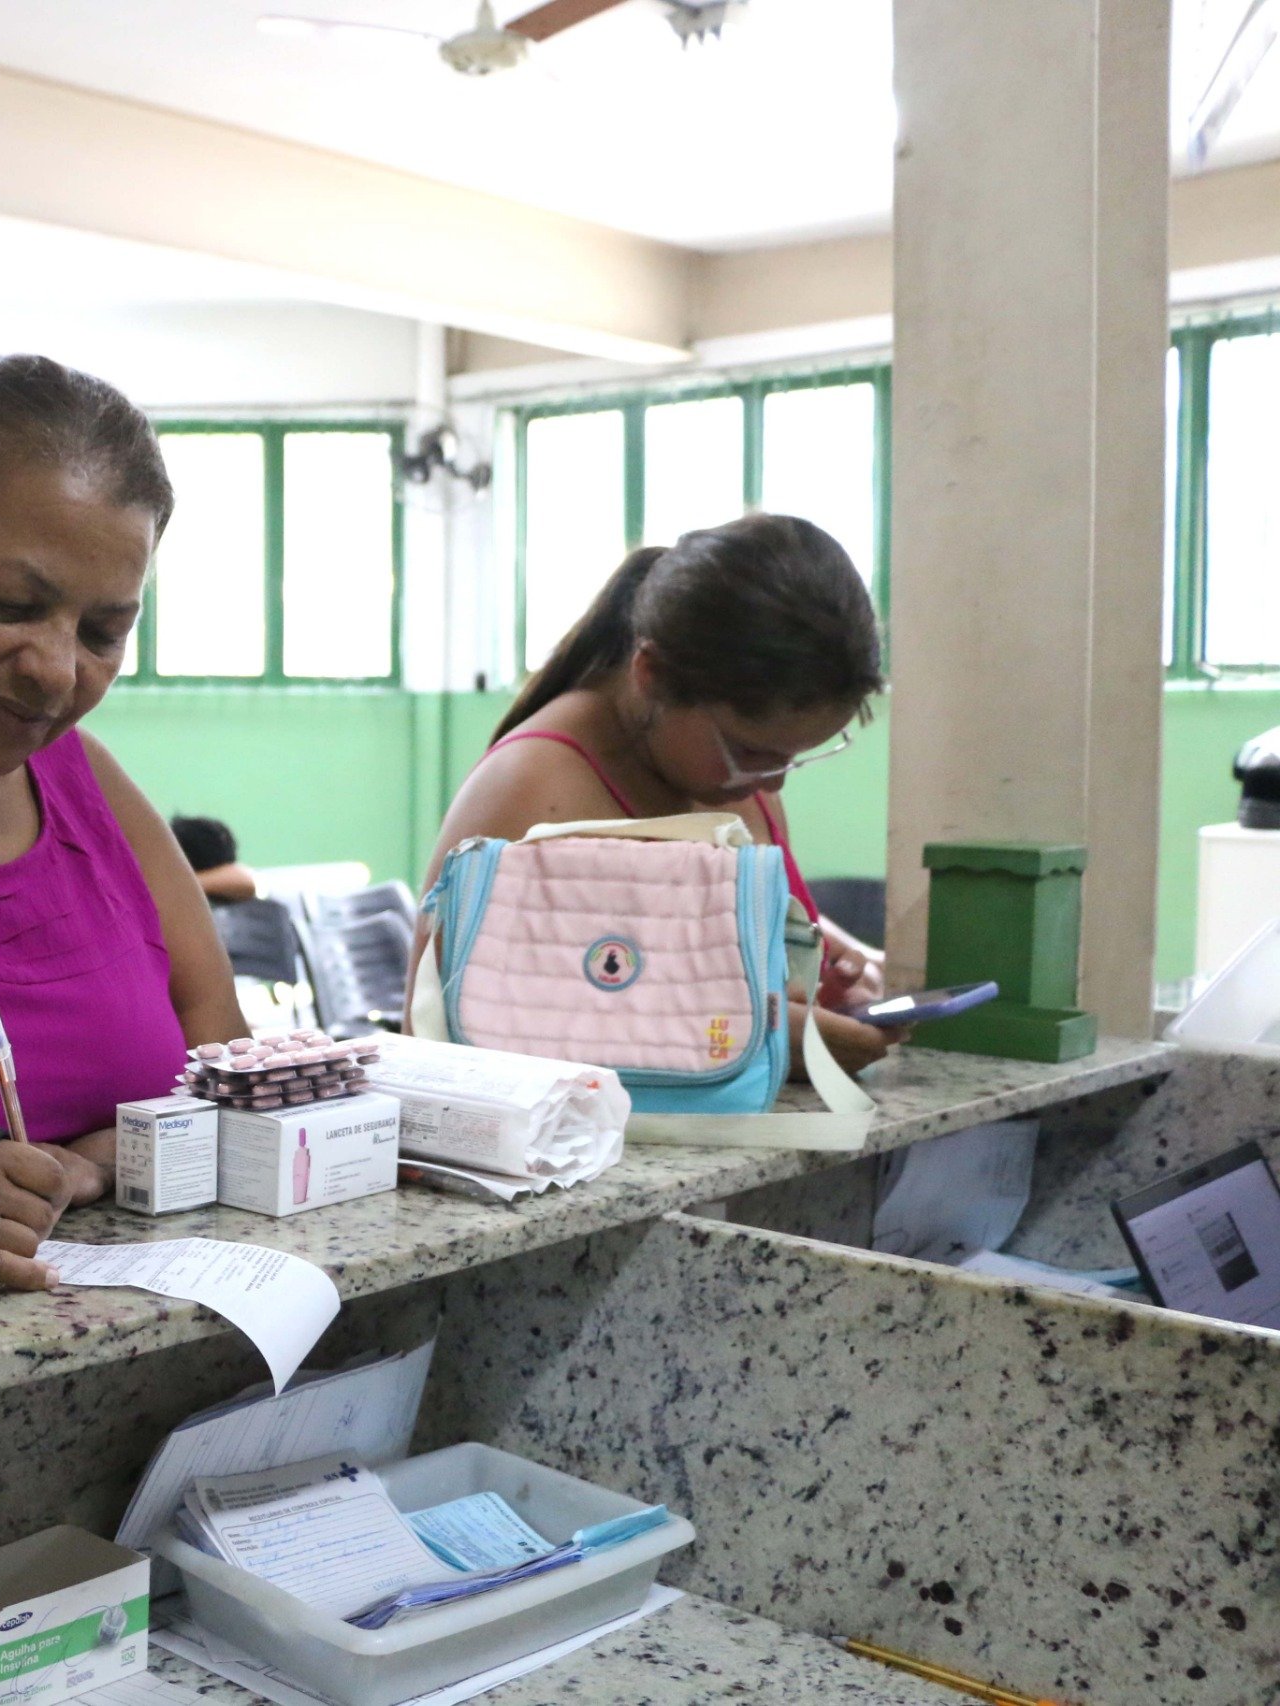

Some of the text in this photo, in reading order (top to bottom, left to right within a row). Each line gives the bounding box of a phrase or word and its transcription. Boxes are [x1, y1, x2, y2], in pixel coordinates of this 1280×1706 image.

[122, 1115, 151, 1131] Medisign
[159, 1118, 193, 1131] Medisign
[326, 1117, 396, 1140] LANCETA DE SEGURANÇA
[0, 1635, 60, 1661] Agulha para
[0, 1655, 39, 1674] Insulina
